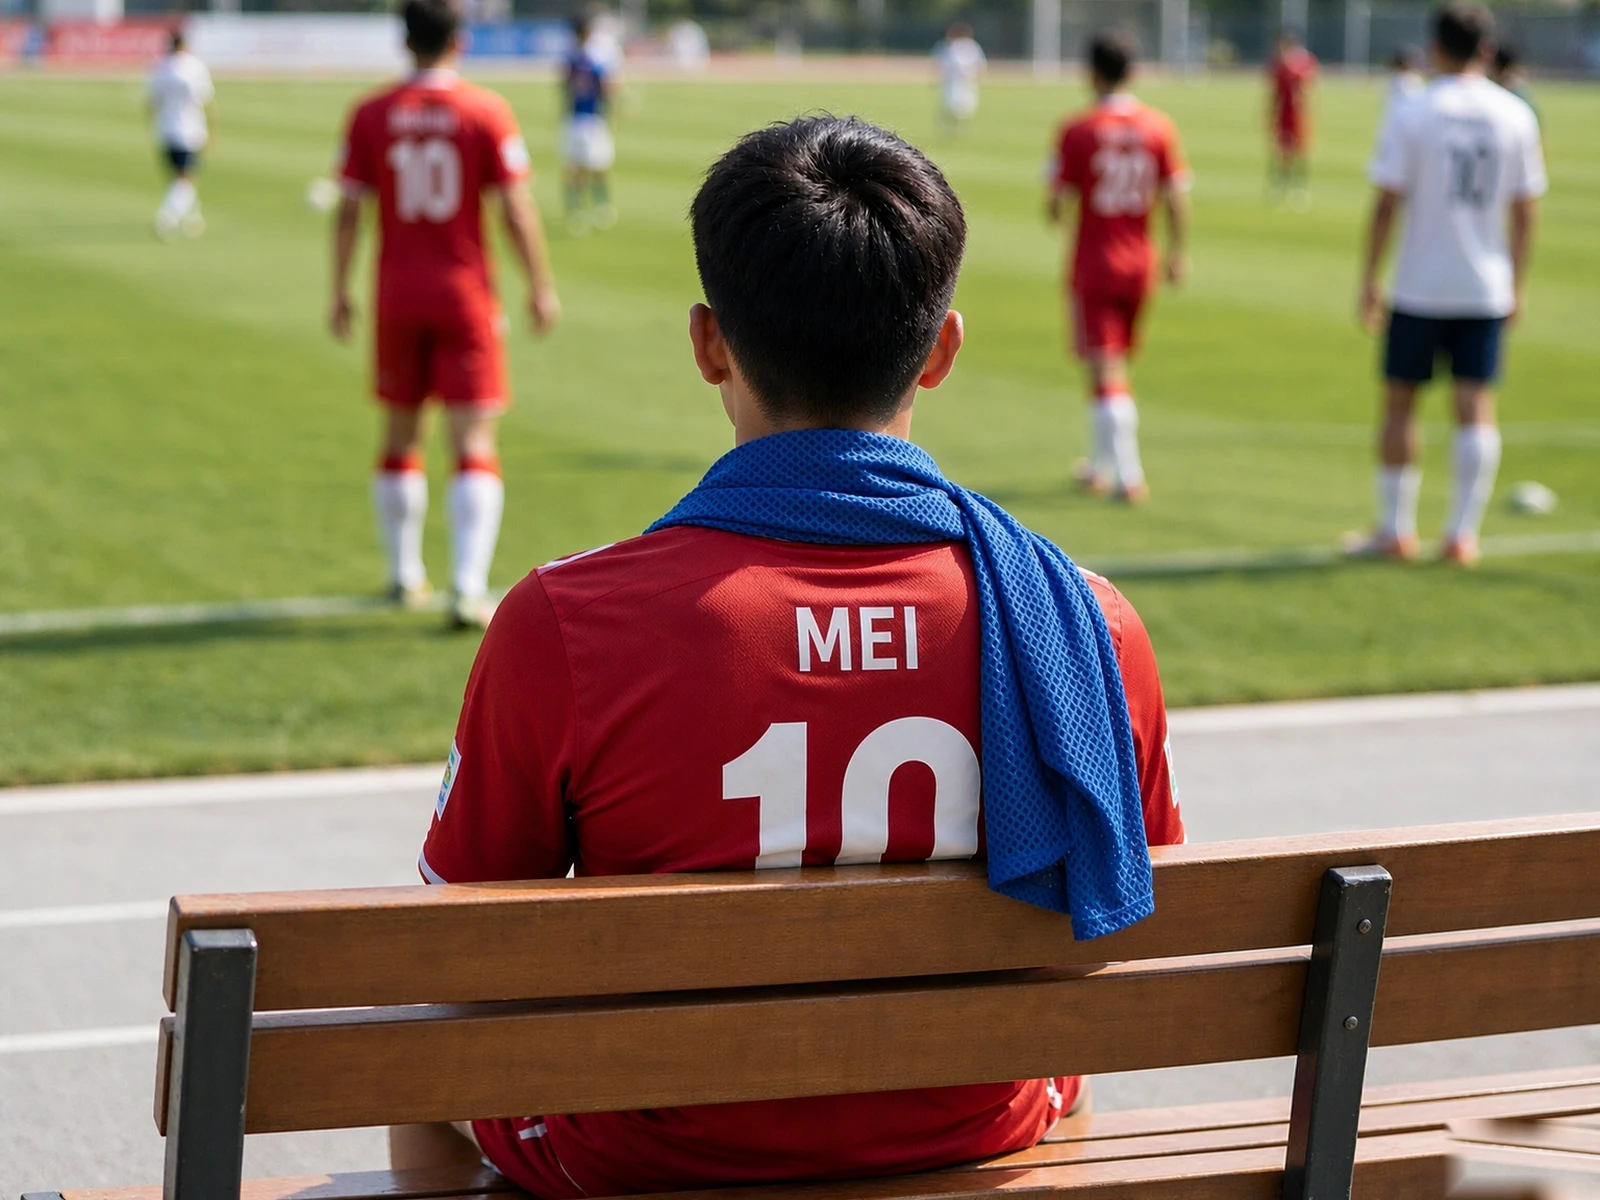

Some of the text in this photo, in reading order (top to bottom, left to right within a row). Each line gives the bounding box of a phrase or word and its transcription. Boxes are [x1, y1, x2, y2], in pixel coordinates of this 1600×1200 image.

[386, 136, 463, 222] 10
[796, 606, 918, 671] MEI
[722, 716, 981, 869] 10
